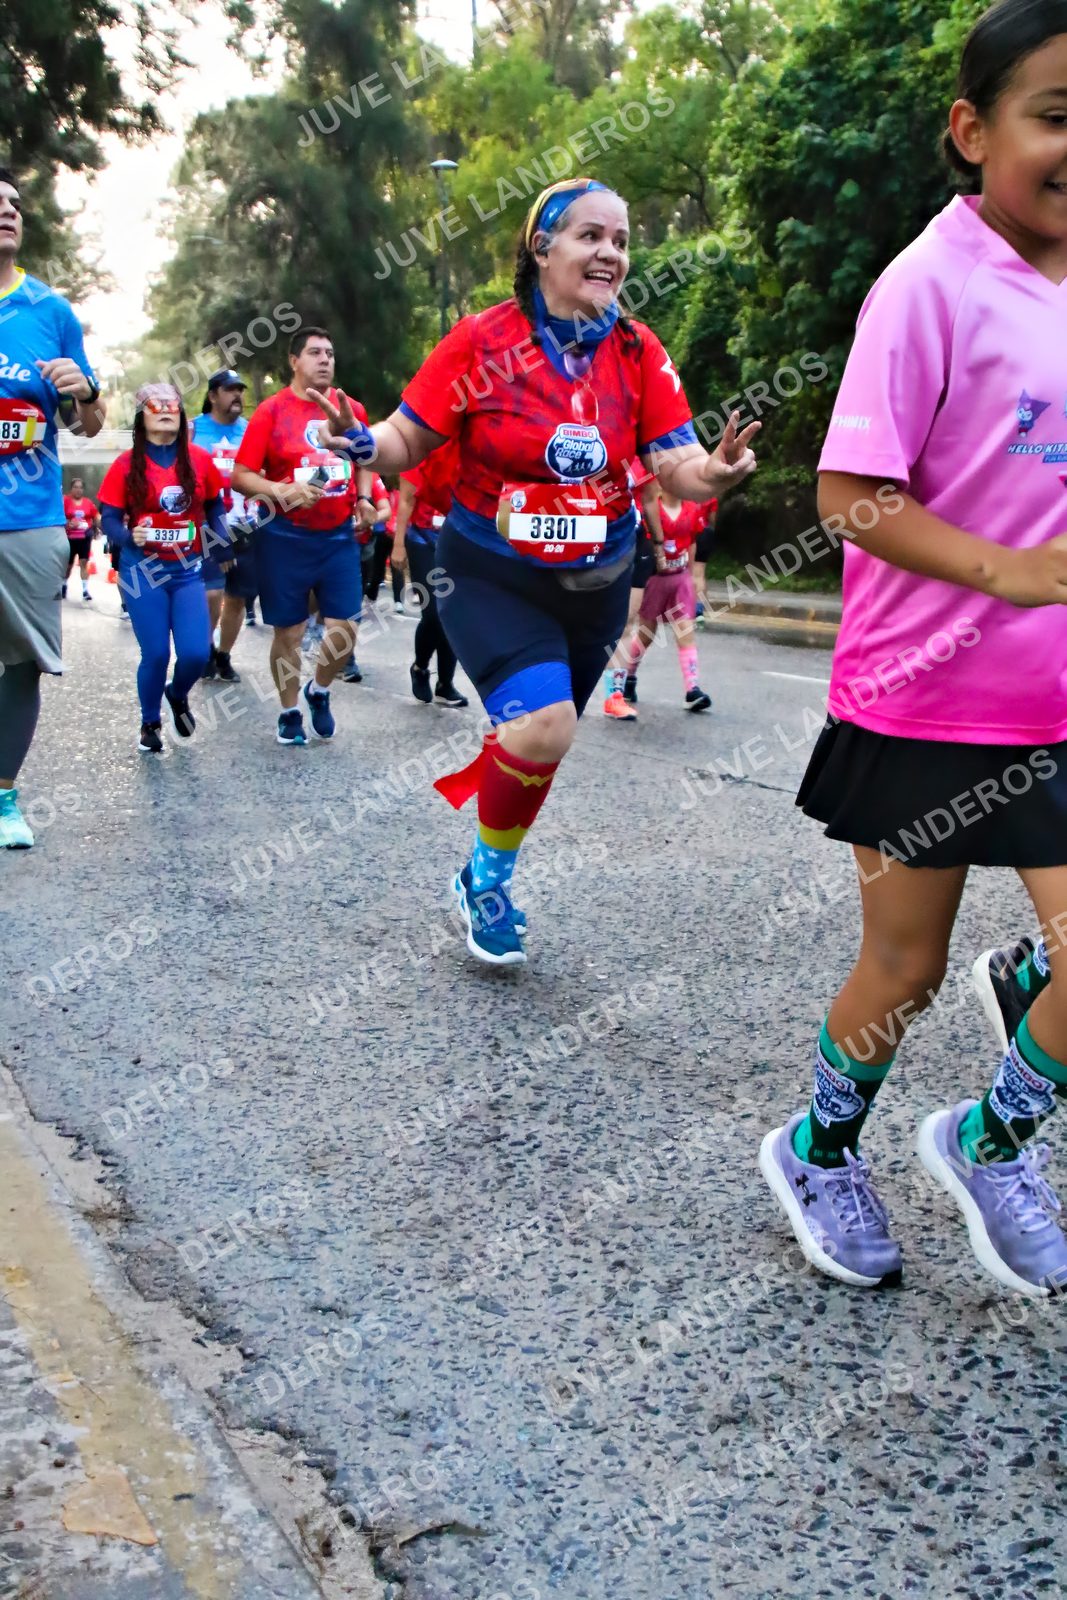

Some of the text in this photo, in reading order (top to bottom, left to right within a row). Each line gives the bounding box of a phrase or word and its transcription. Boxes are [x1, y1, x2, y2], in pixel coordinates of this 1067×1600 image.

[563, 429, 593, 438] BIMBO
[563, 439, 594, 452] Global
[1007, 444, 1043, 454] HELLO
[555, 448, 582, 459] Race
[530, 516, 577, 540] 3301
[155, 529, 180, 540] 3337
